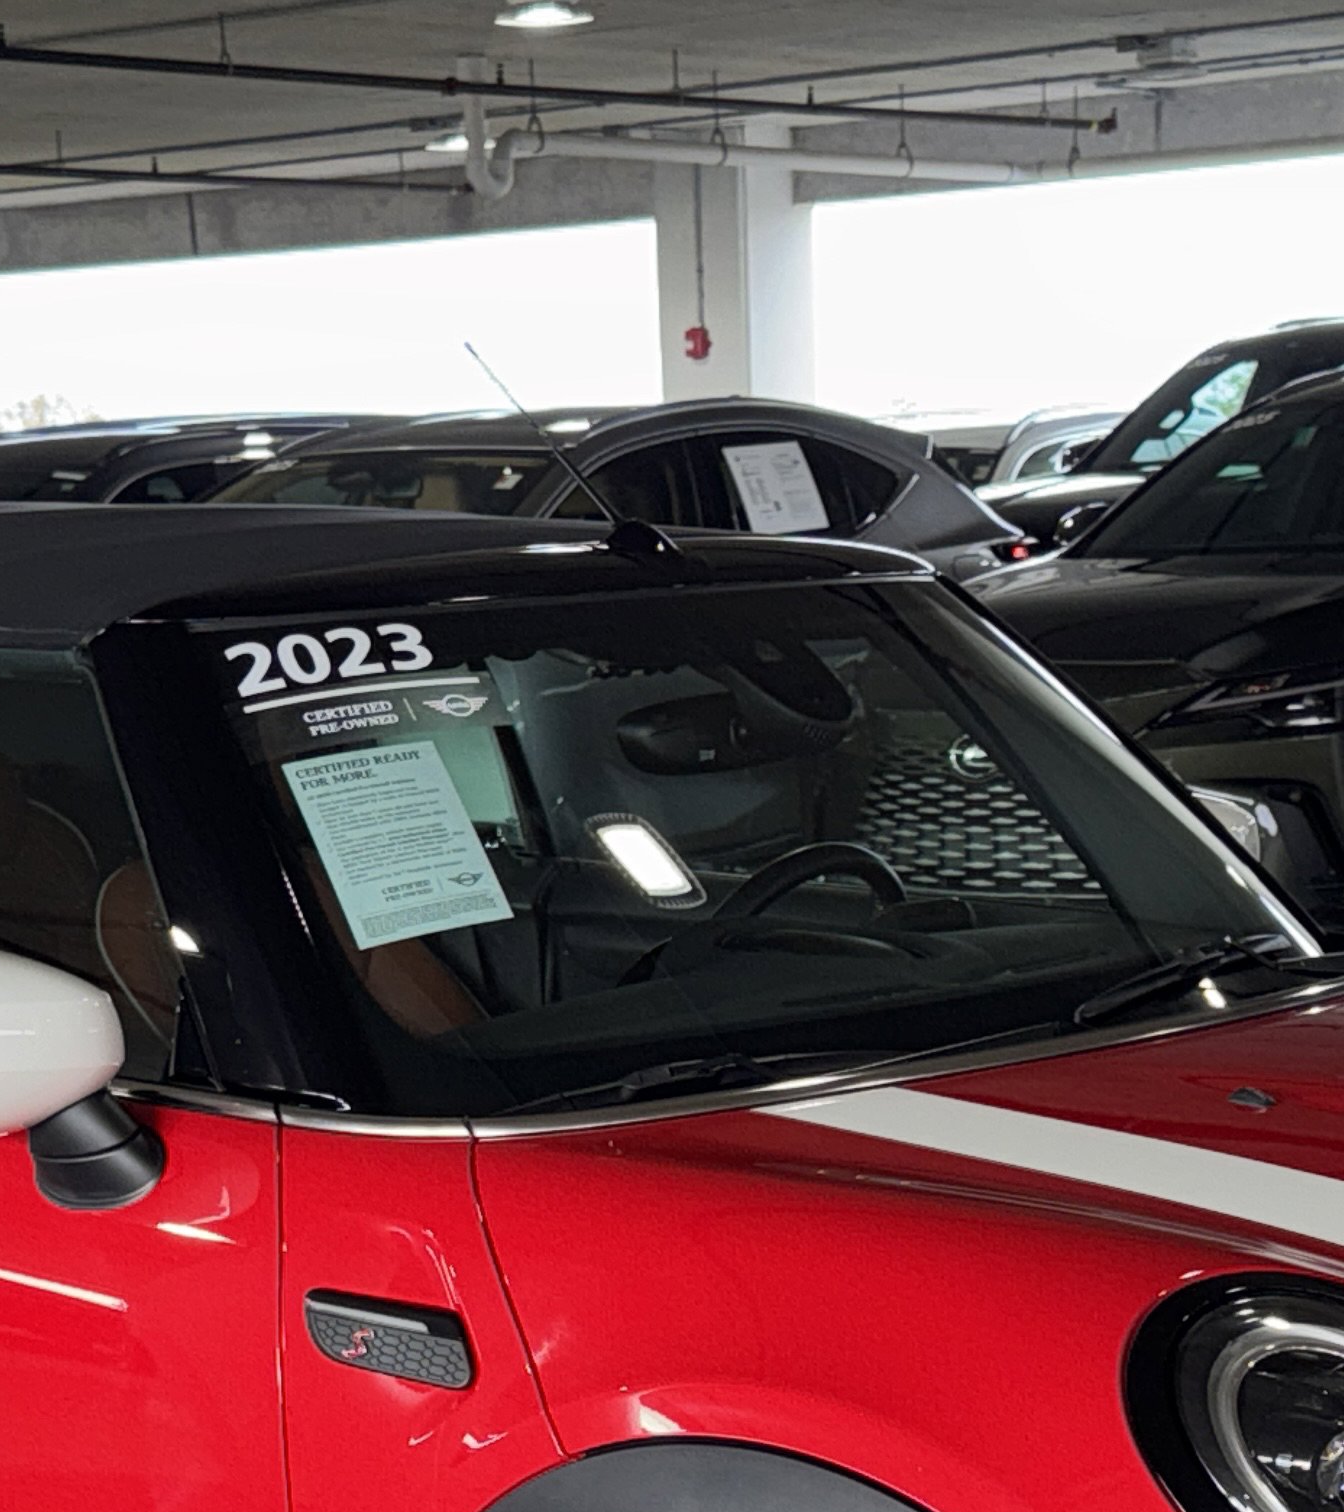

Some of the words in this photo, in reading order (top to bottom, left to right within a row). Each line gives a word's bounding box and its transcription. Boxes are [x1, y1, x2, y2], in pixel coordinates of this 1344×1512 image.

[223, 622, 434, 698] 2023
[302, 701, 393, 724] CERTIFIED
[308, 714, 399, 736] PRE-OWNED
[295, 757, 370, 779] CERTIFIED
[373, 750, 421, 765] READY
[299, 776, 329, 791] FOR
